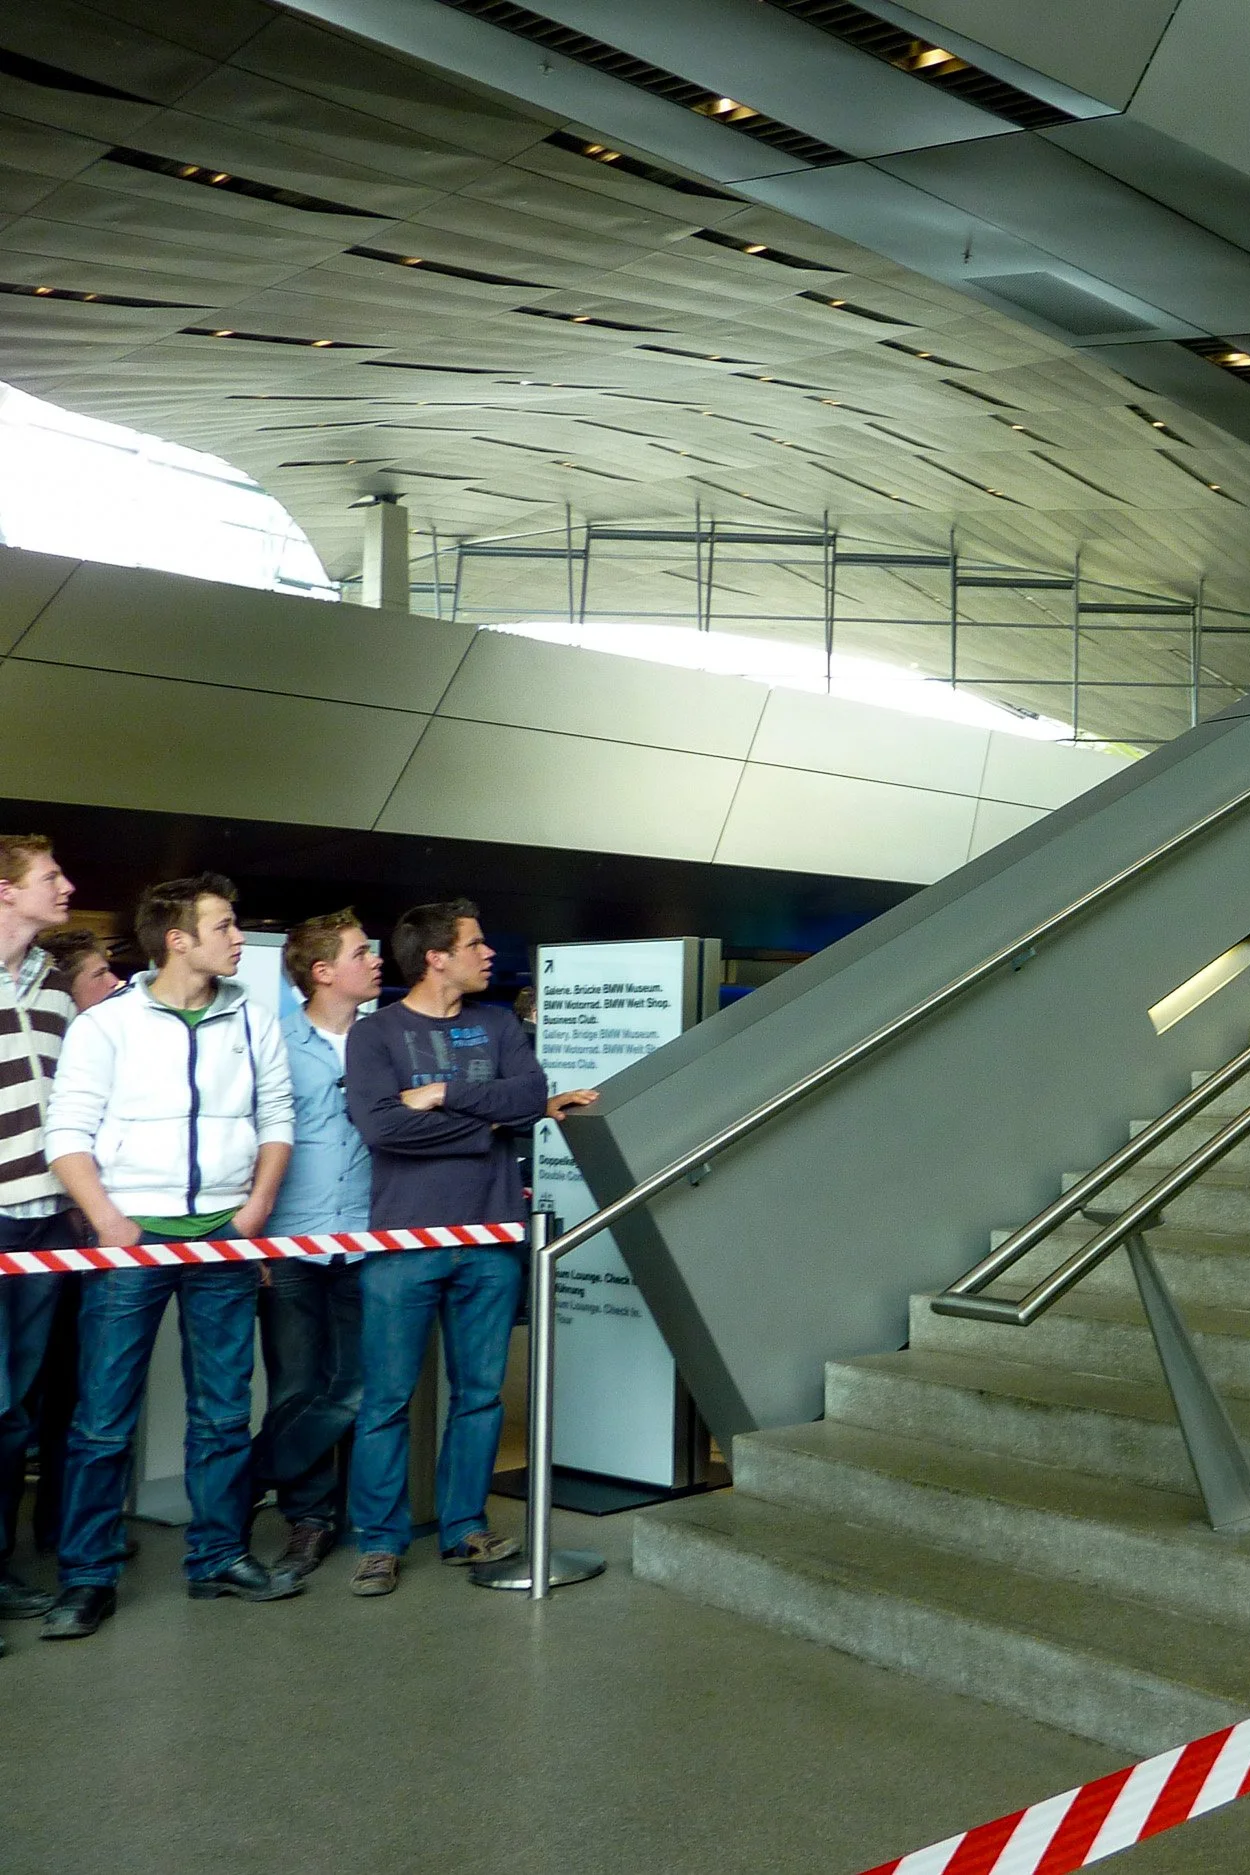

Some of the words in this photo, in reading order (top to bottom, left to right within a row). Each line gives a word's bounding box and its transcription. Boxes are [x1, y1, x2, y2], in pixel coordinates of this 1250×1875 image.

[574, 984, 601, 995] Brücke
[602, 983, 624, 994] BMW
[625, 983, 663, 994] Museum.
[543, 1000, 563, 1010] BMW
[564, 999, 602, 1010] Motorrad.
[603, 998, 624, 1009] BMW
[626, 998, 644, 1008] Welt
[646, 997, 671, 1010] Shop.
[543, 1015, 577, 1025] Business
[578, 1014, 599, 1024] Club.
[600, 1028, 620, 1039] BMW
[542, 1044, 562, 1054] BMW
[602, 1043, 624, 1054] BMW
[625, 1043, 643, 1054] Welt
[603, 1272, 630, 1285] Check
